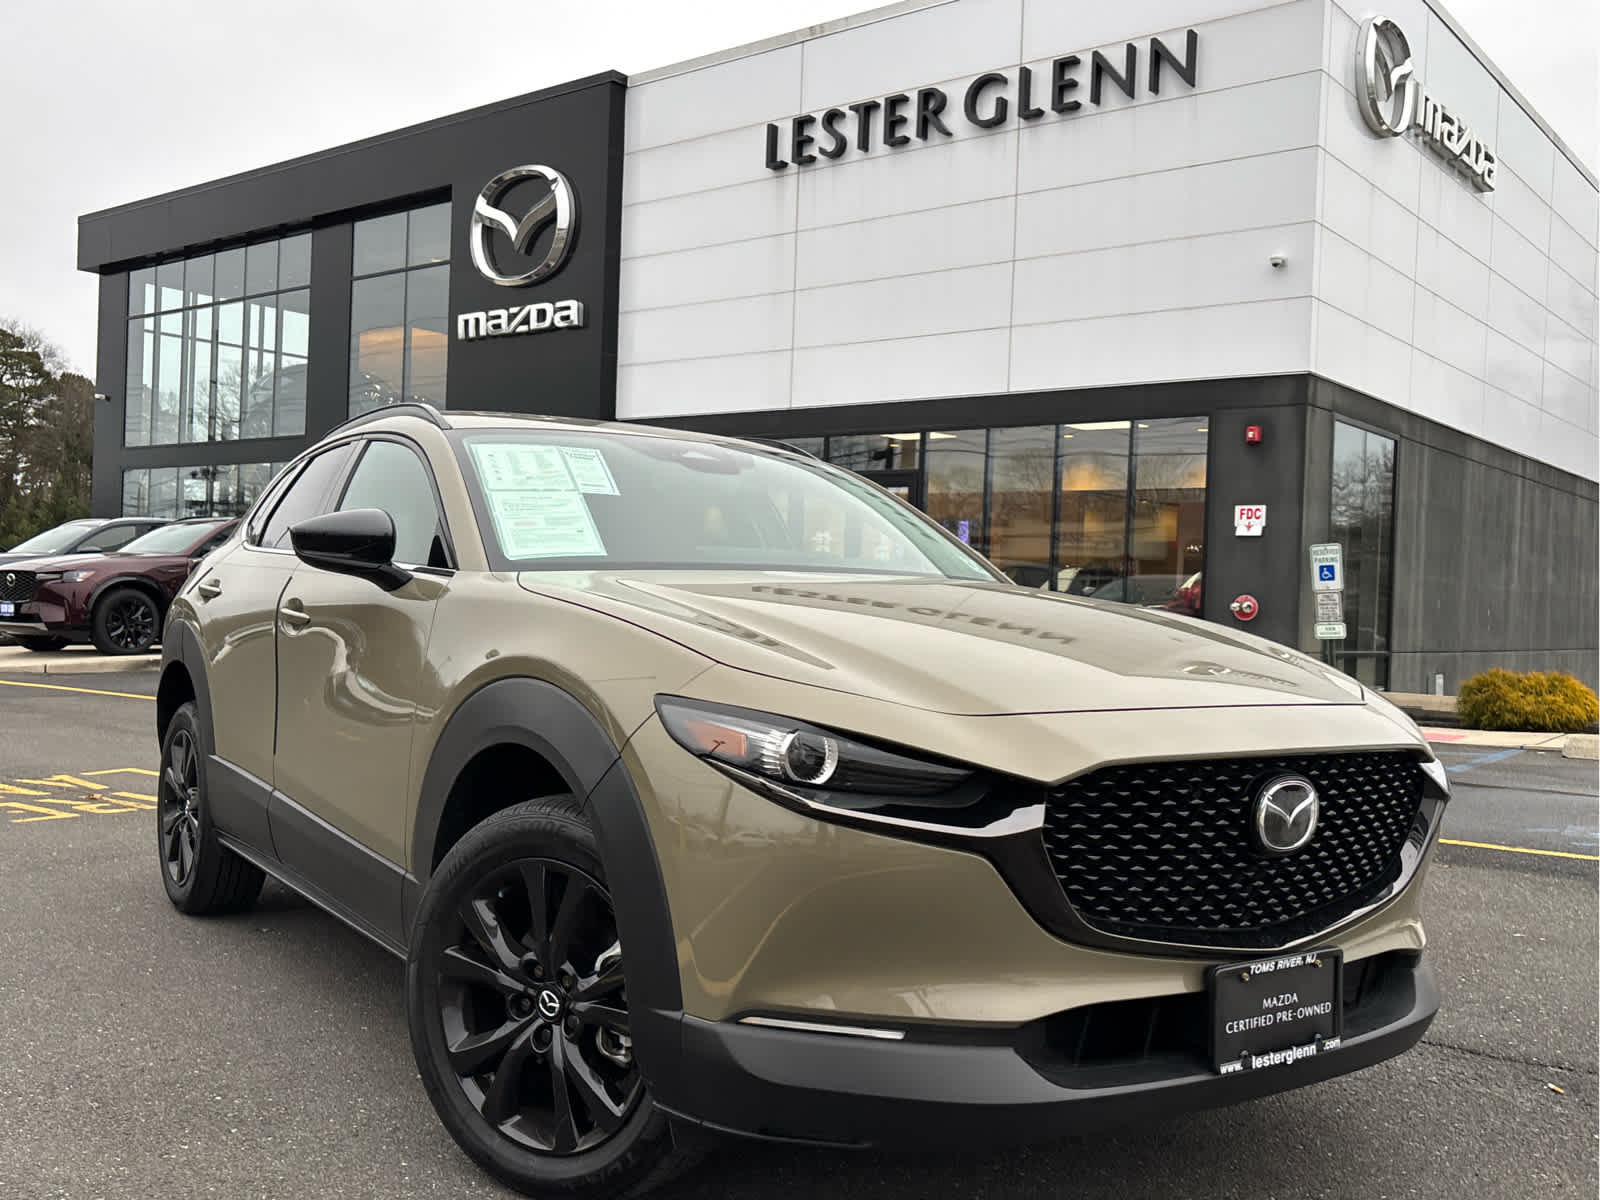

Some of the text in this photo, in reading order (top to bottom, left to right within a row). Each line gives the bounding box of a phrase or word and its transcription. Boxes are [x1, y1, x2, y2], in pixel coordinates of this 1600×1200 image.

[765, 28, 1199, 171] LESTER GLENN
[457, 299, 584, 340] mazda
[1239, 507, 1262, 520] FDC
[1250, 961, 1275, 975] TOMS
[1305, 953, 1317, 964] NJ
[1262, 992, 1298, 1009] MAZDA
[1225, 1002, 1332, 1034] CERTIFIED PRE-OWNED
[1220, 1038, 1341, 1075] www. lesterglenn .com
